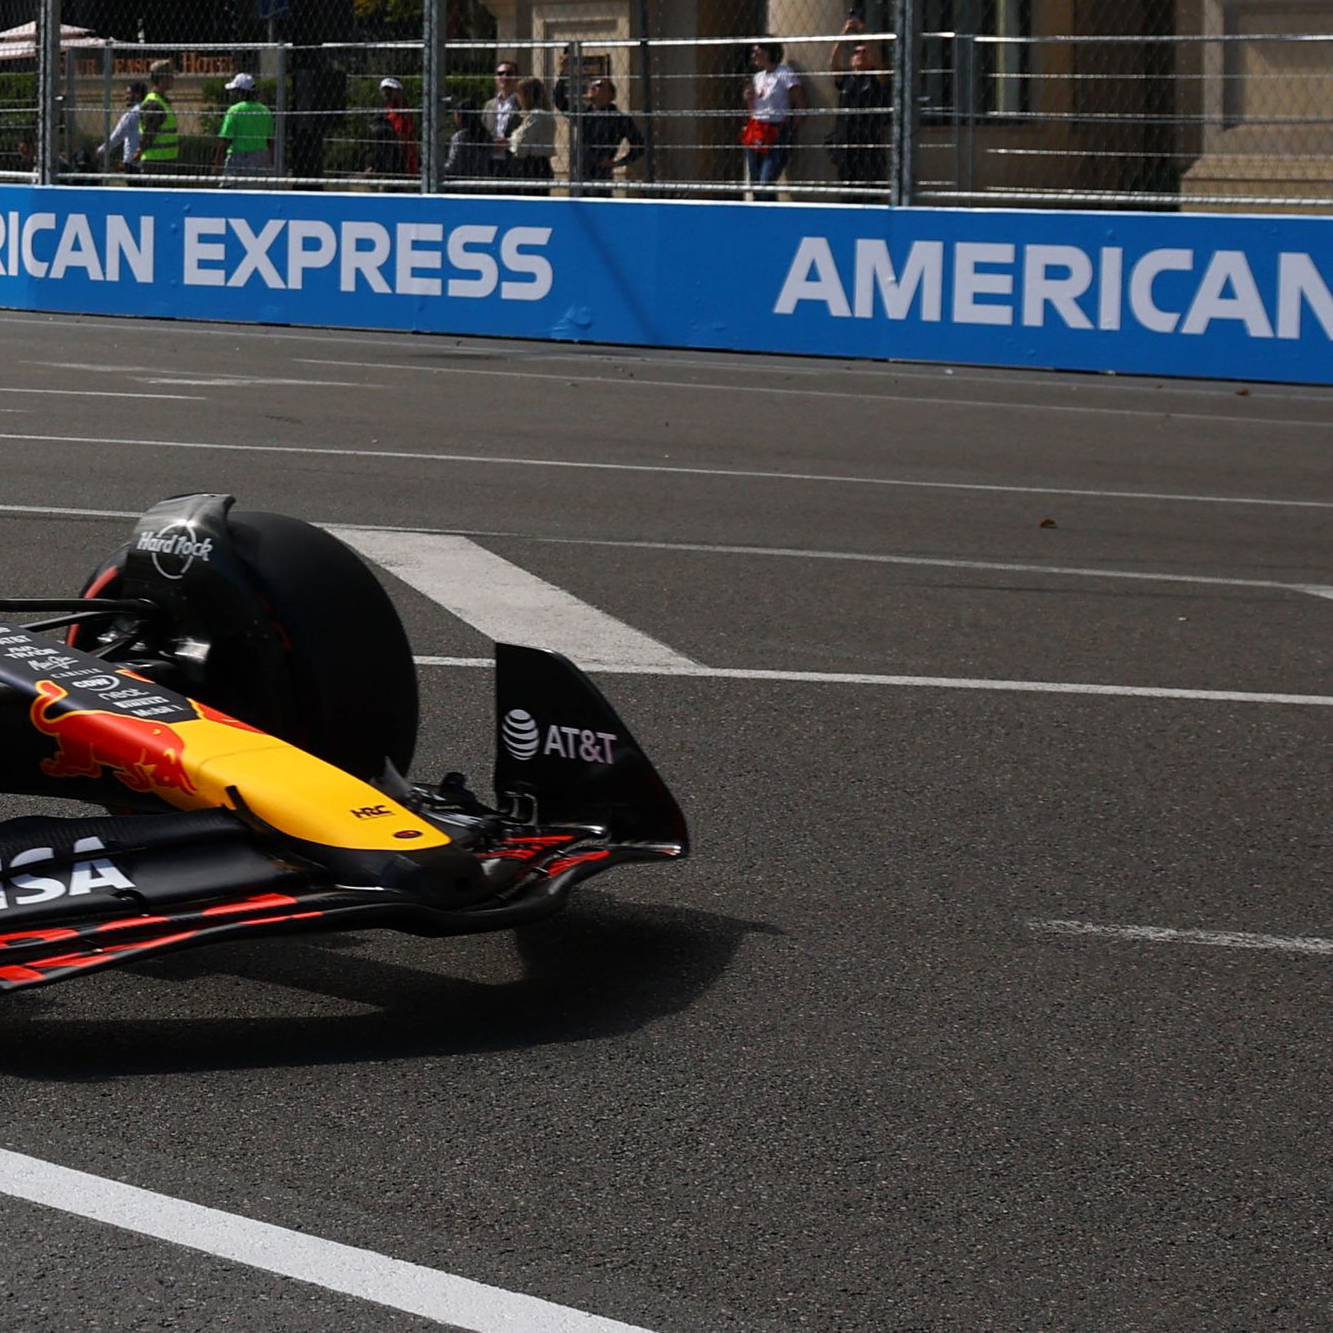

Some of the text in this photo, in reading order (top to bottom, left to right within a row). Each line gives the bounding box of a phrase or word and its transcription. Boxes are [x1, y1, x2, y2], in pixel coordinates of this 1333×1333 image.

[183, 214, 555, 303] EXPRESS
[772, 235, 1333, 343] AMERICAN
[136, 530, 178, 555] Hard
[3, 648, 60, 660] TRADE
[71, 677, 111, 689] CDW
[544, 726, 619, 765] AT&T
[349, 804, 392, 819] HRC
